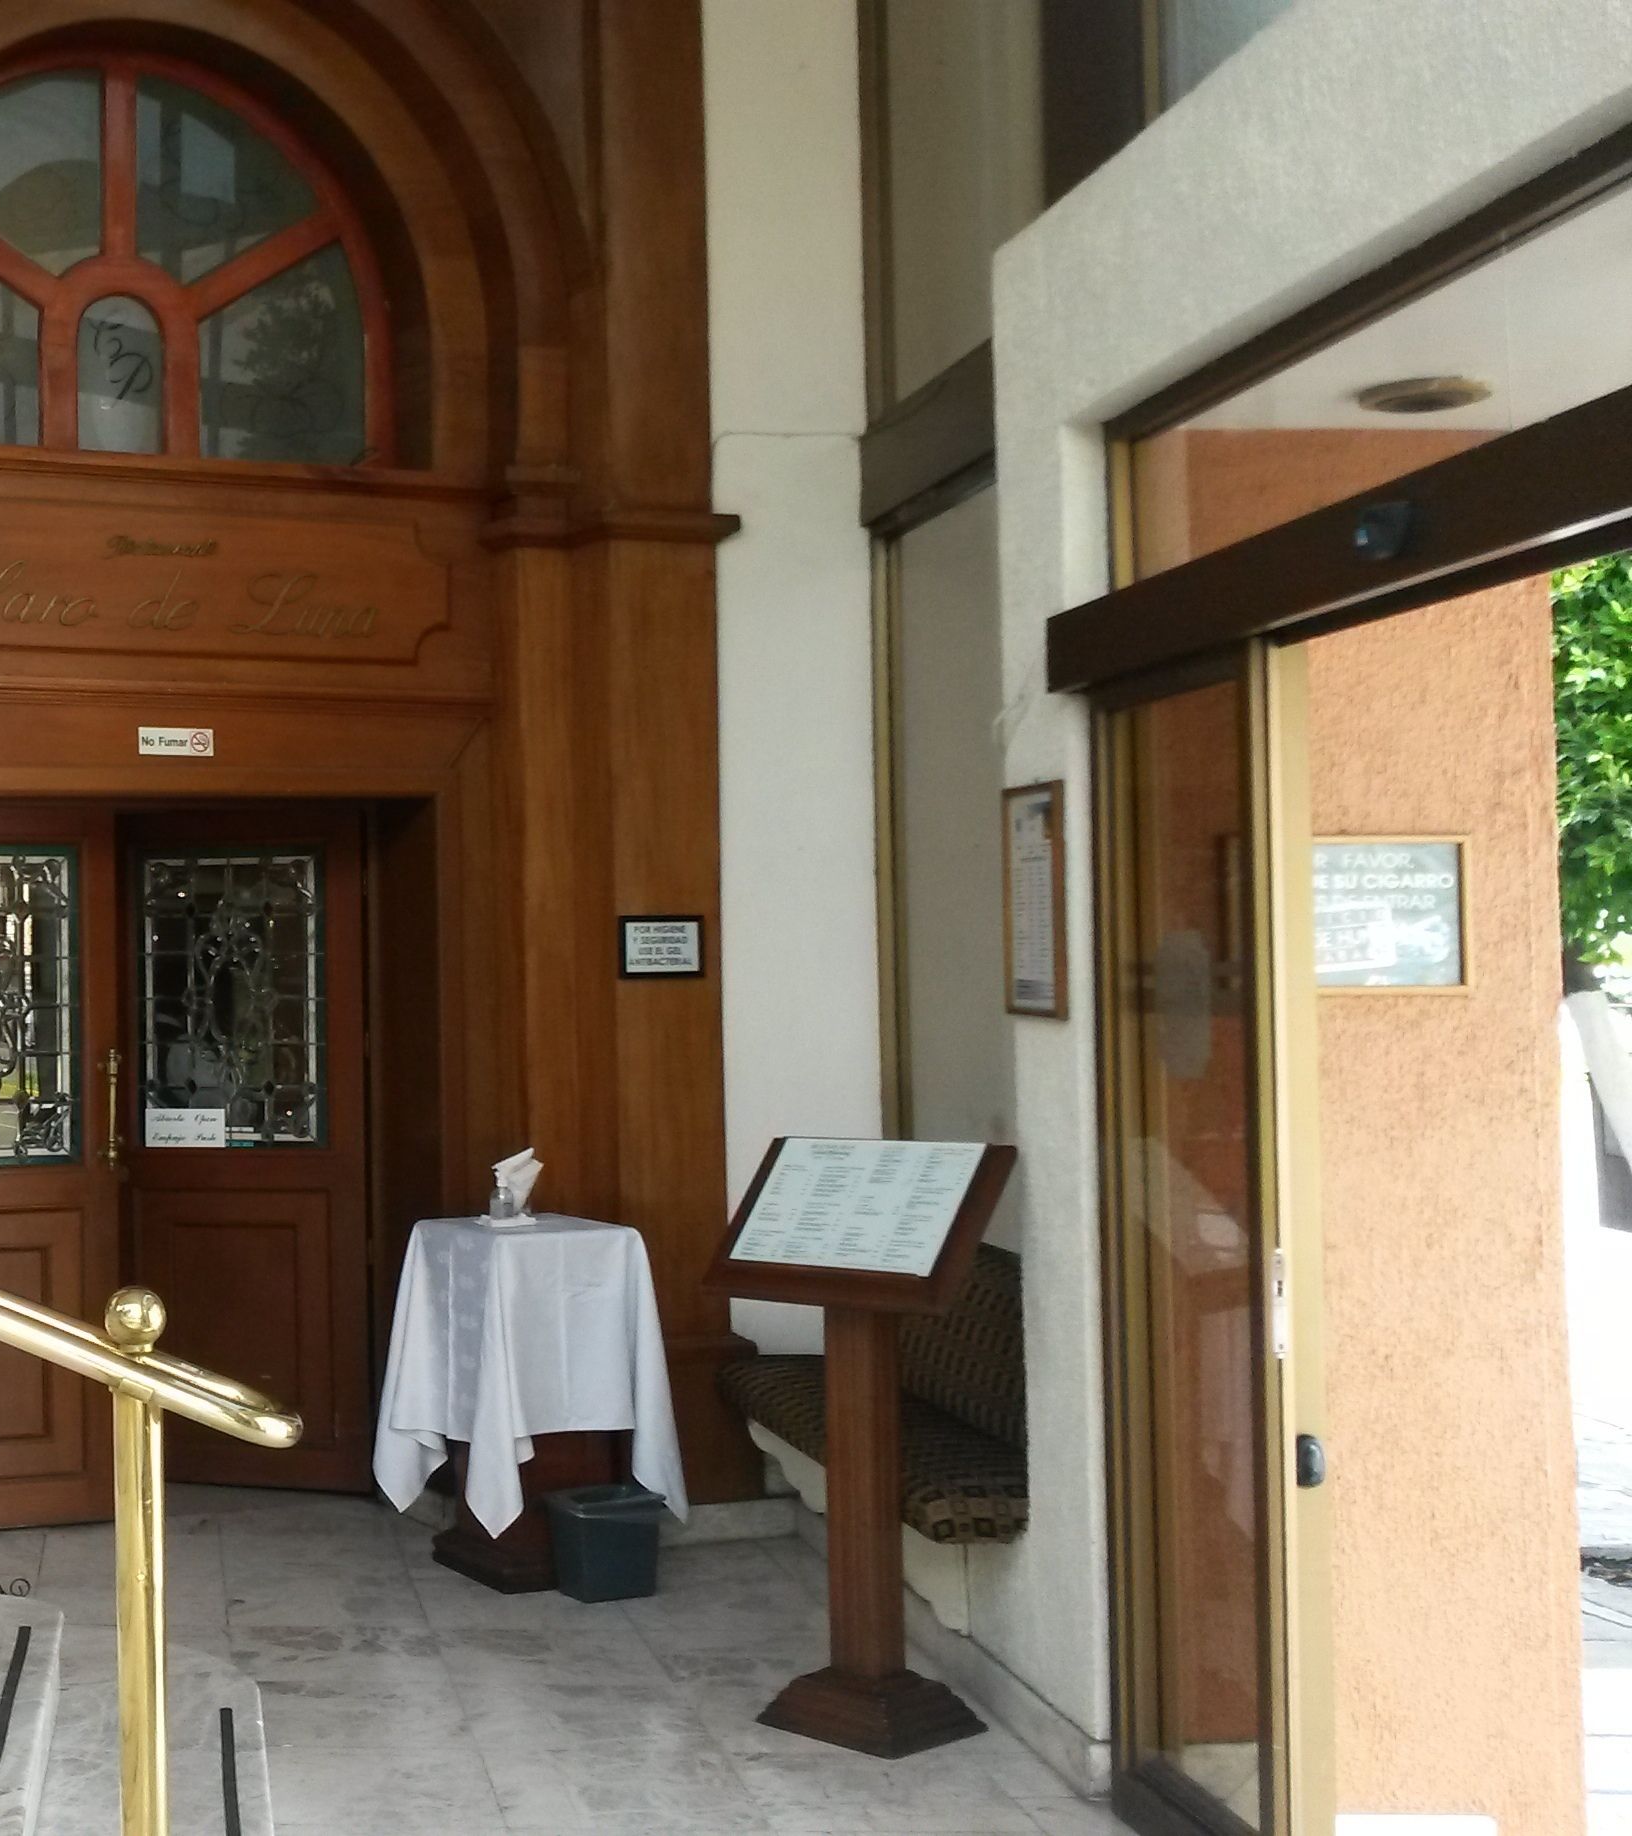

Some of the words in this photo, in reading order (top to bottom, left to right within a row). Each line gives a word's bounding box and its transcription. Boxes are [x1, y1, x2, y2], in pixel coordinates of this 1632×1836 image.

[125, 570, 200, 631] de
[231, 573, 380, 640] Luna
[141, 735, 155, 747] No
[158, 736, 188, 747] Fumar
[1333, 874, 1358, 889] SU
[1361, 873, 1455, 889] CIGARRO
[633, 925, 651, 934] POR
